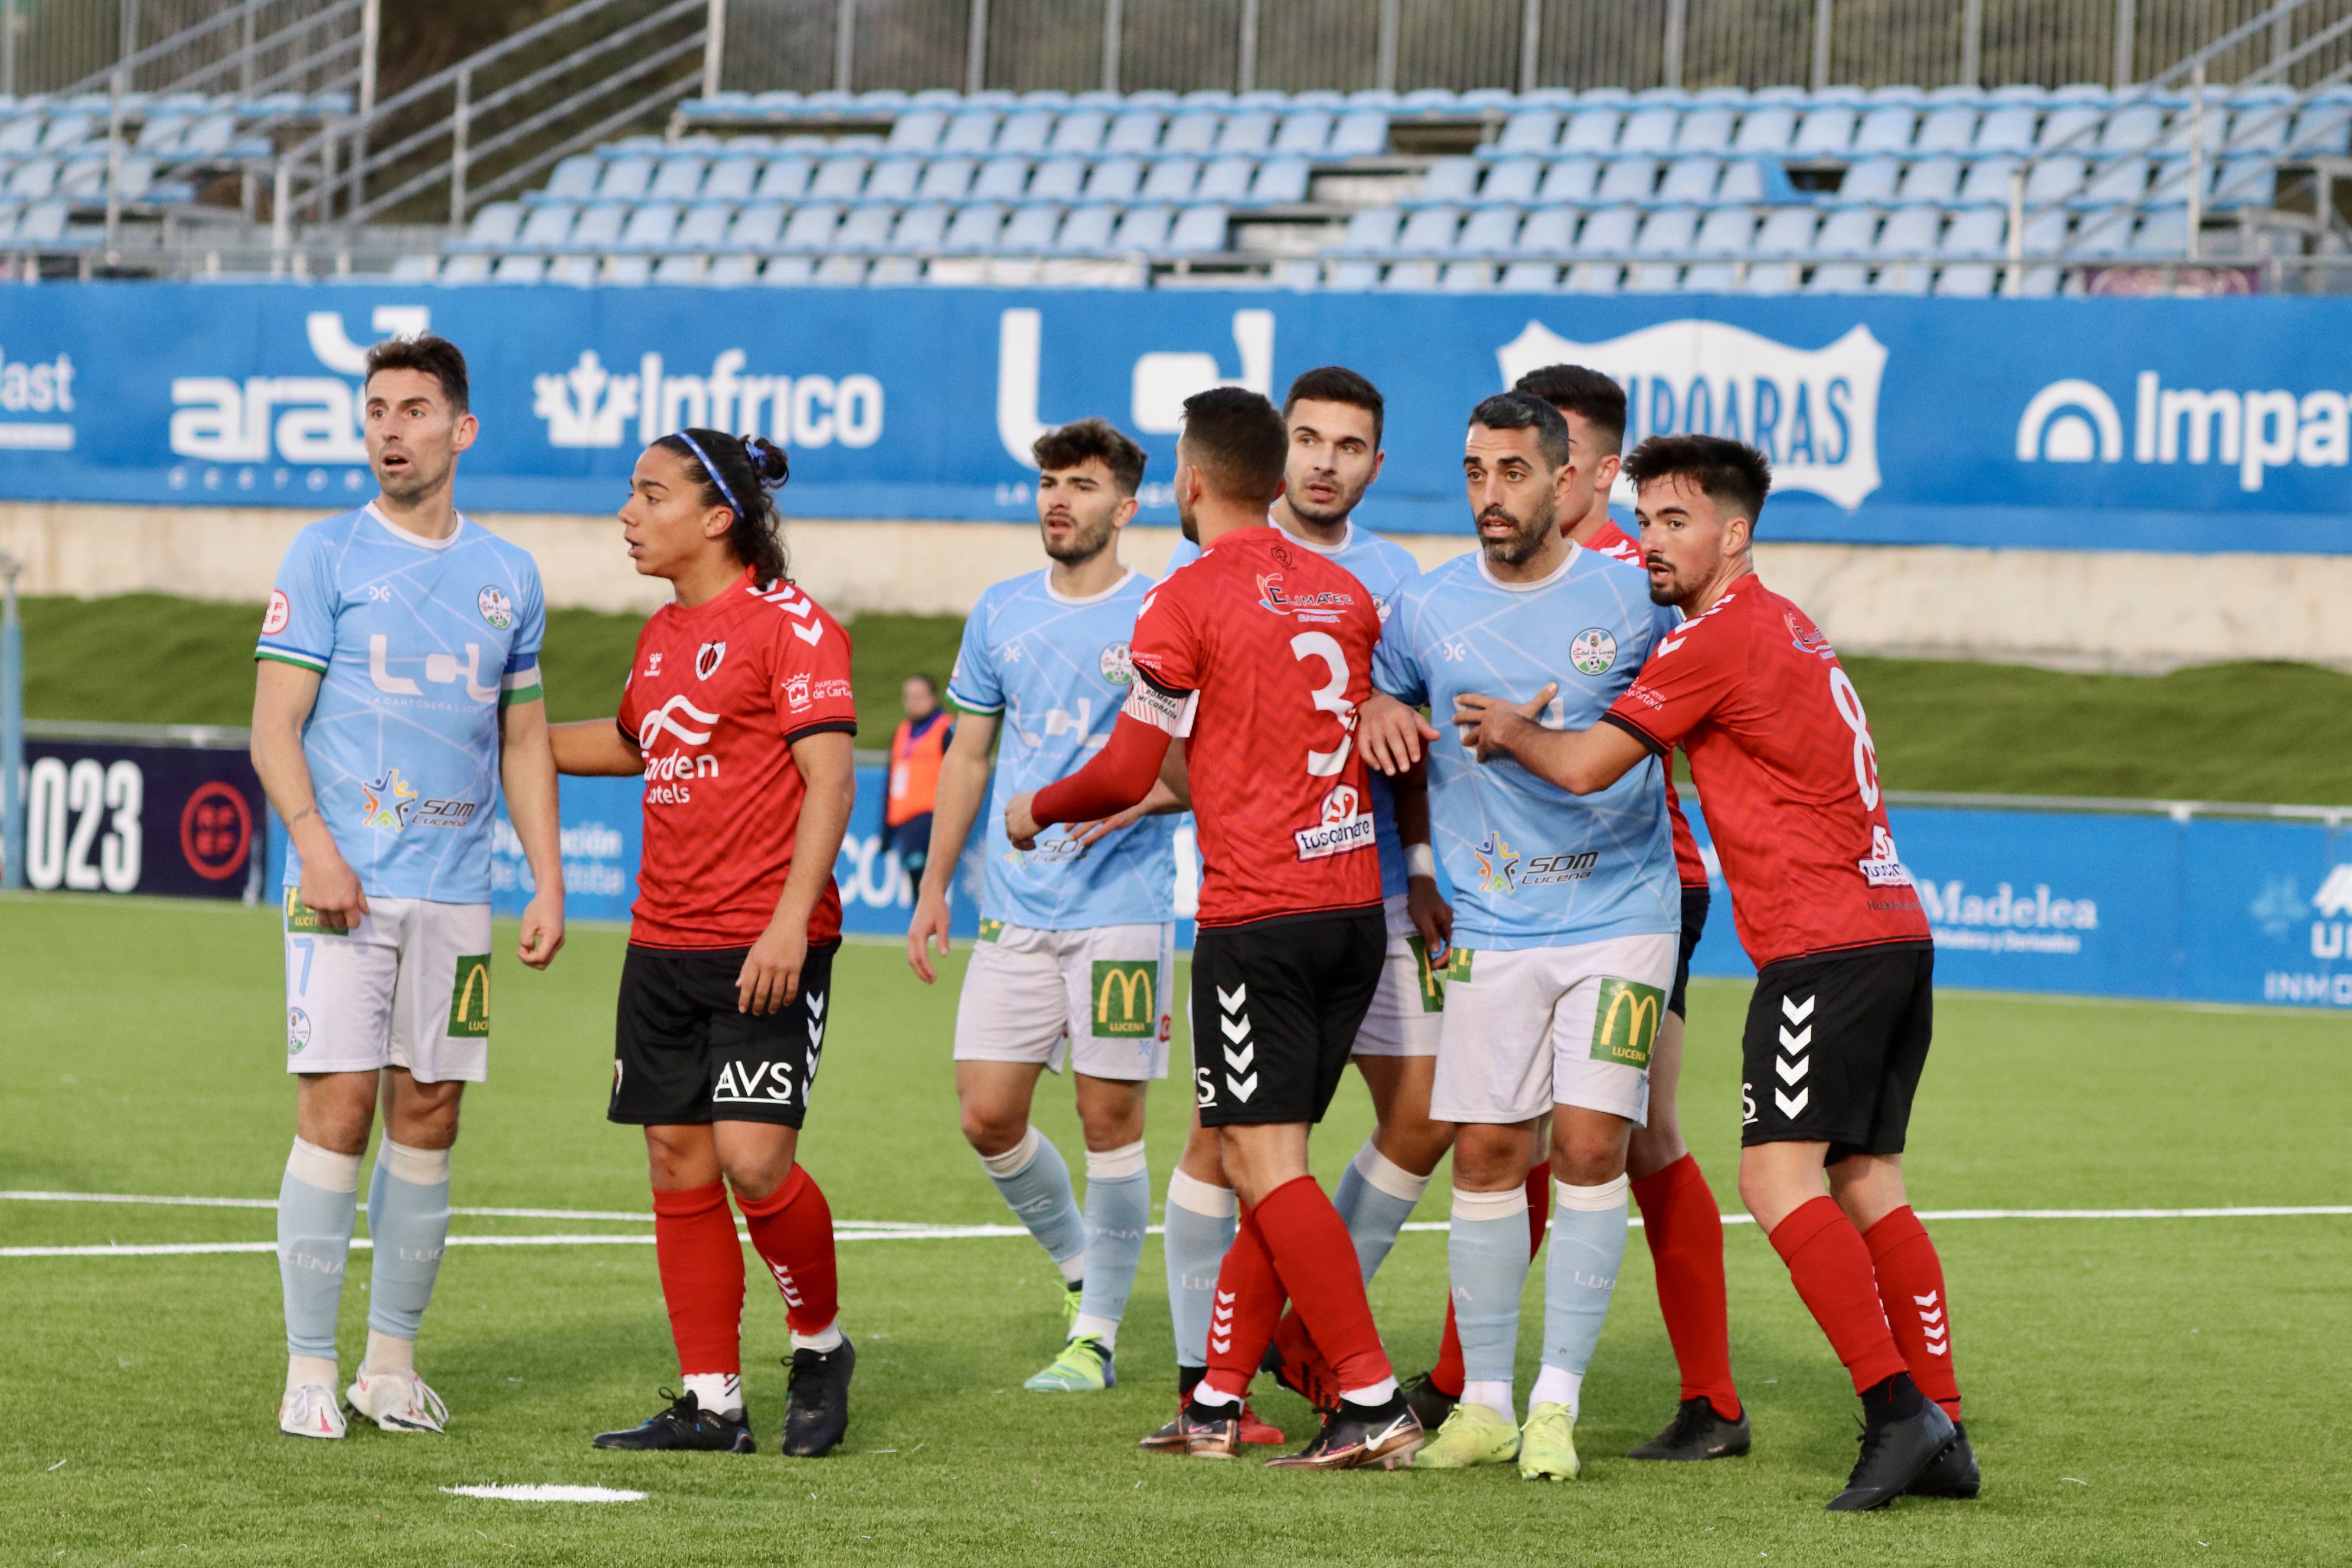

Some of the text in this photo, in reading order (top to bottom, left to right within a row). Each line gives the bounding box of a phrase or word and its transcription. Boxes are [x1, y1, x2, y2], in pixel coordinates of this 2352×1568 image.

[0, 345, 75, 411] ast
[639, 349, 883, 448] Infrico
[171, 378, 370, 463] ara
[2135, 371, 2352, 491] Impa
[1137, 694, 1147, 703] MI
[1145, 688, 1177, 709] BOMBEA
[1289, 631, 1357, 777] 3
[1830, 667, 1879, 812] 8
[641, 747, 719, 781] arden
[646, 782, 690, 804] otels
[1521, 871, 1591, 885] Lucena
[1526, 851, 1599, 874] SDM
[1109, 1022, 1145, 1032] LUCENA
[1612, 1046, 1647, 1063] LUCENA
[714, 1061, 793, 1101] AVS
